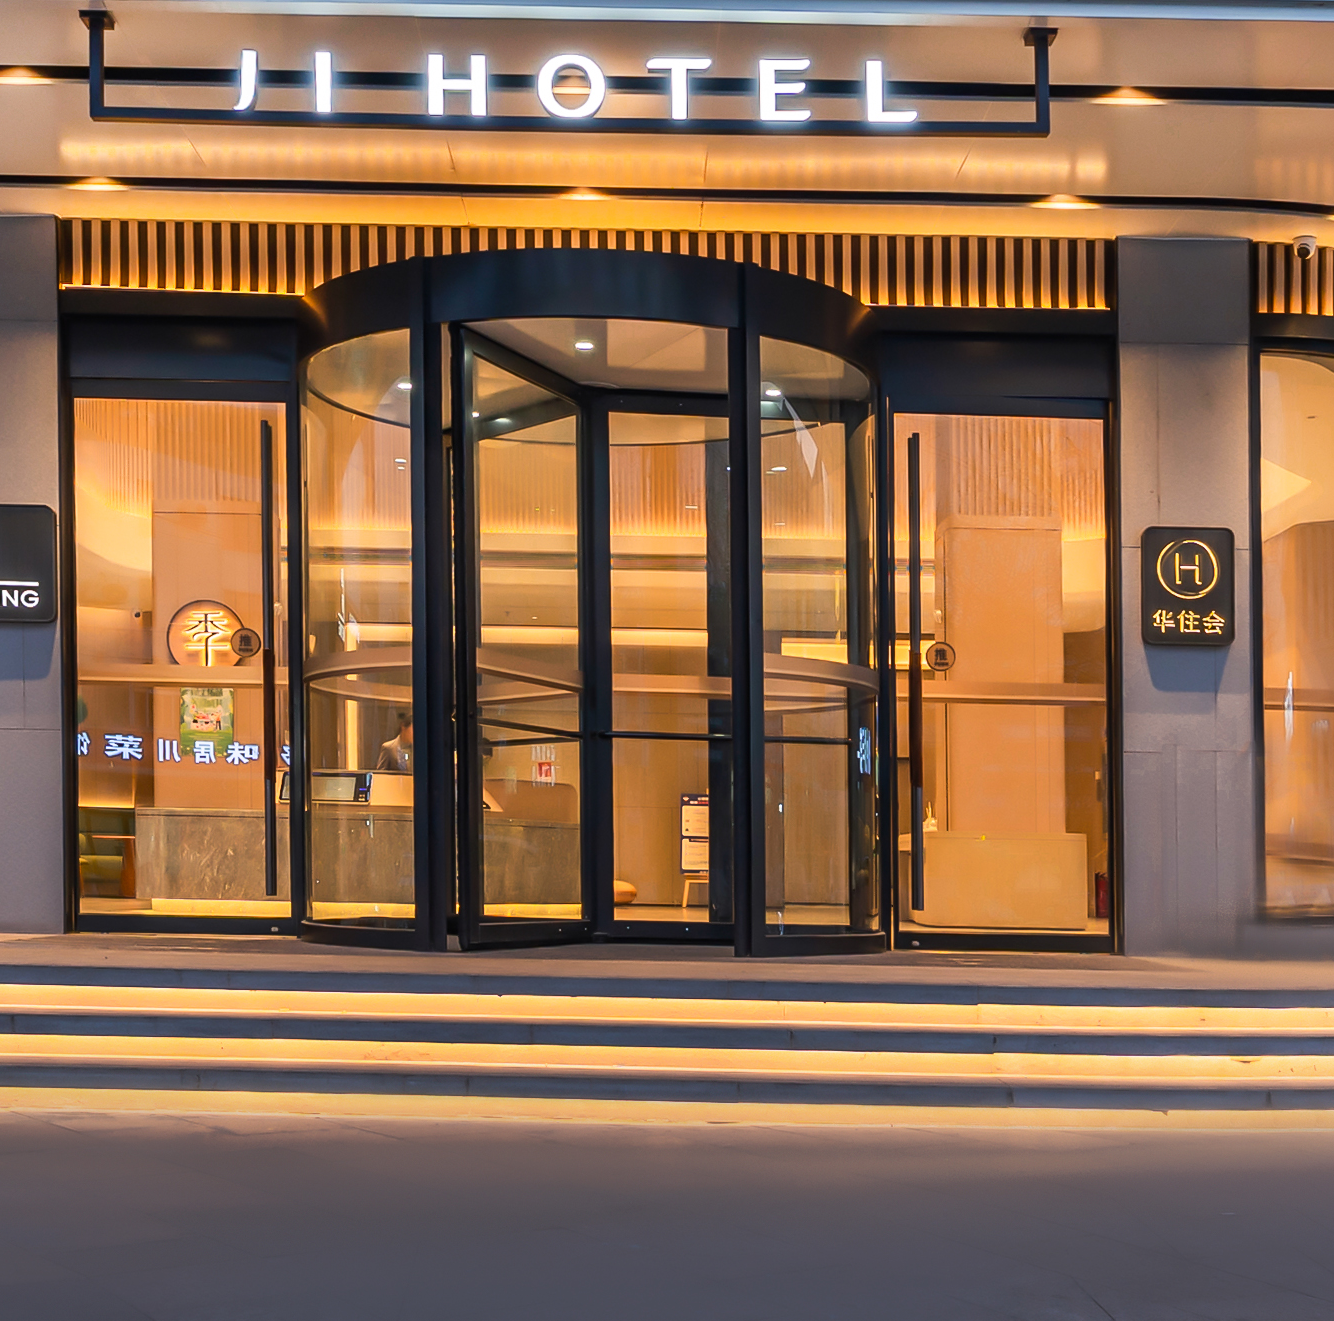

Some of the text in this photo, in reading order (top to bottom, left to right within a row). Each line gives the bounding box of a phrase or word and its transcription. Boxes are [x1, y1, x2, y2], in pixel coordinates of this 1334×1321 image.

[233, 48, 919, 123] JI HOTEL
[183, 610, 230, 666] 季
[1152, 609, 1226, 635] 华住会
